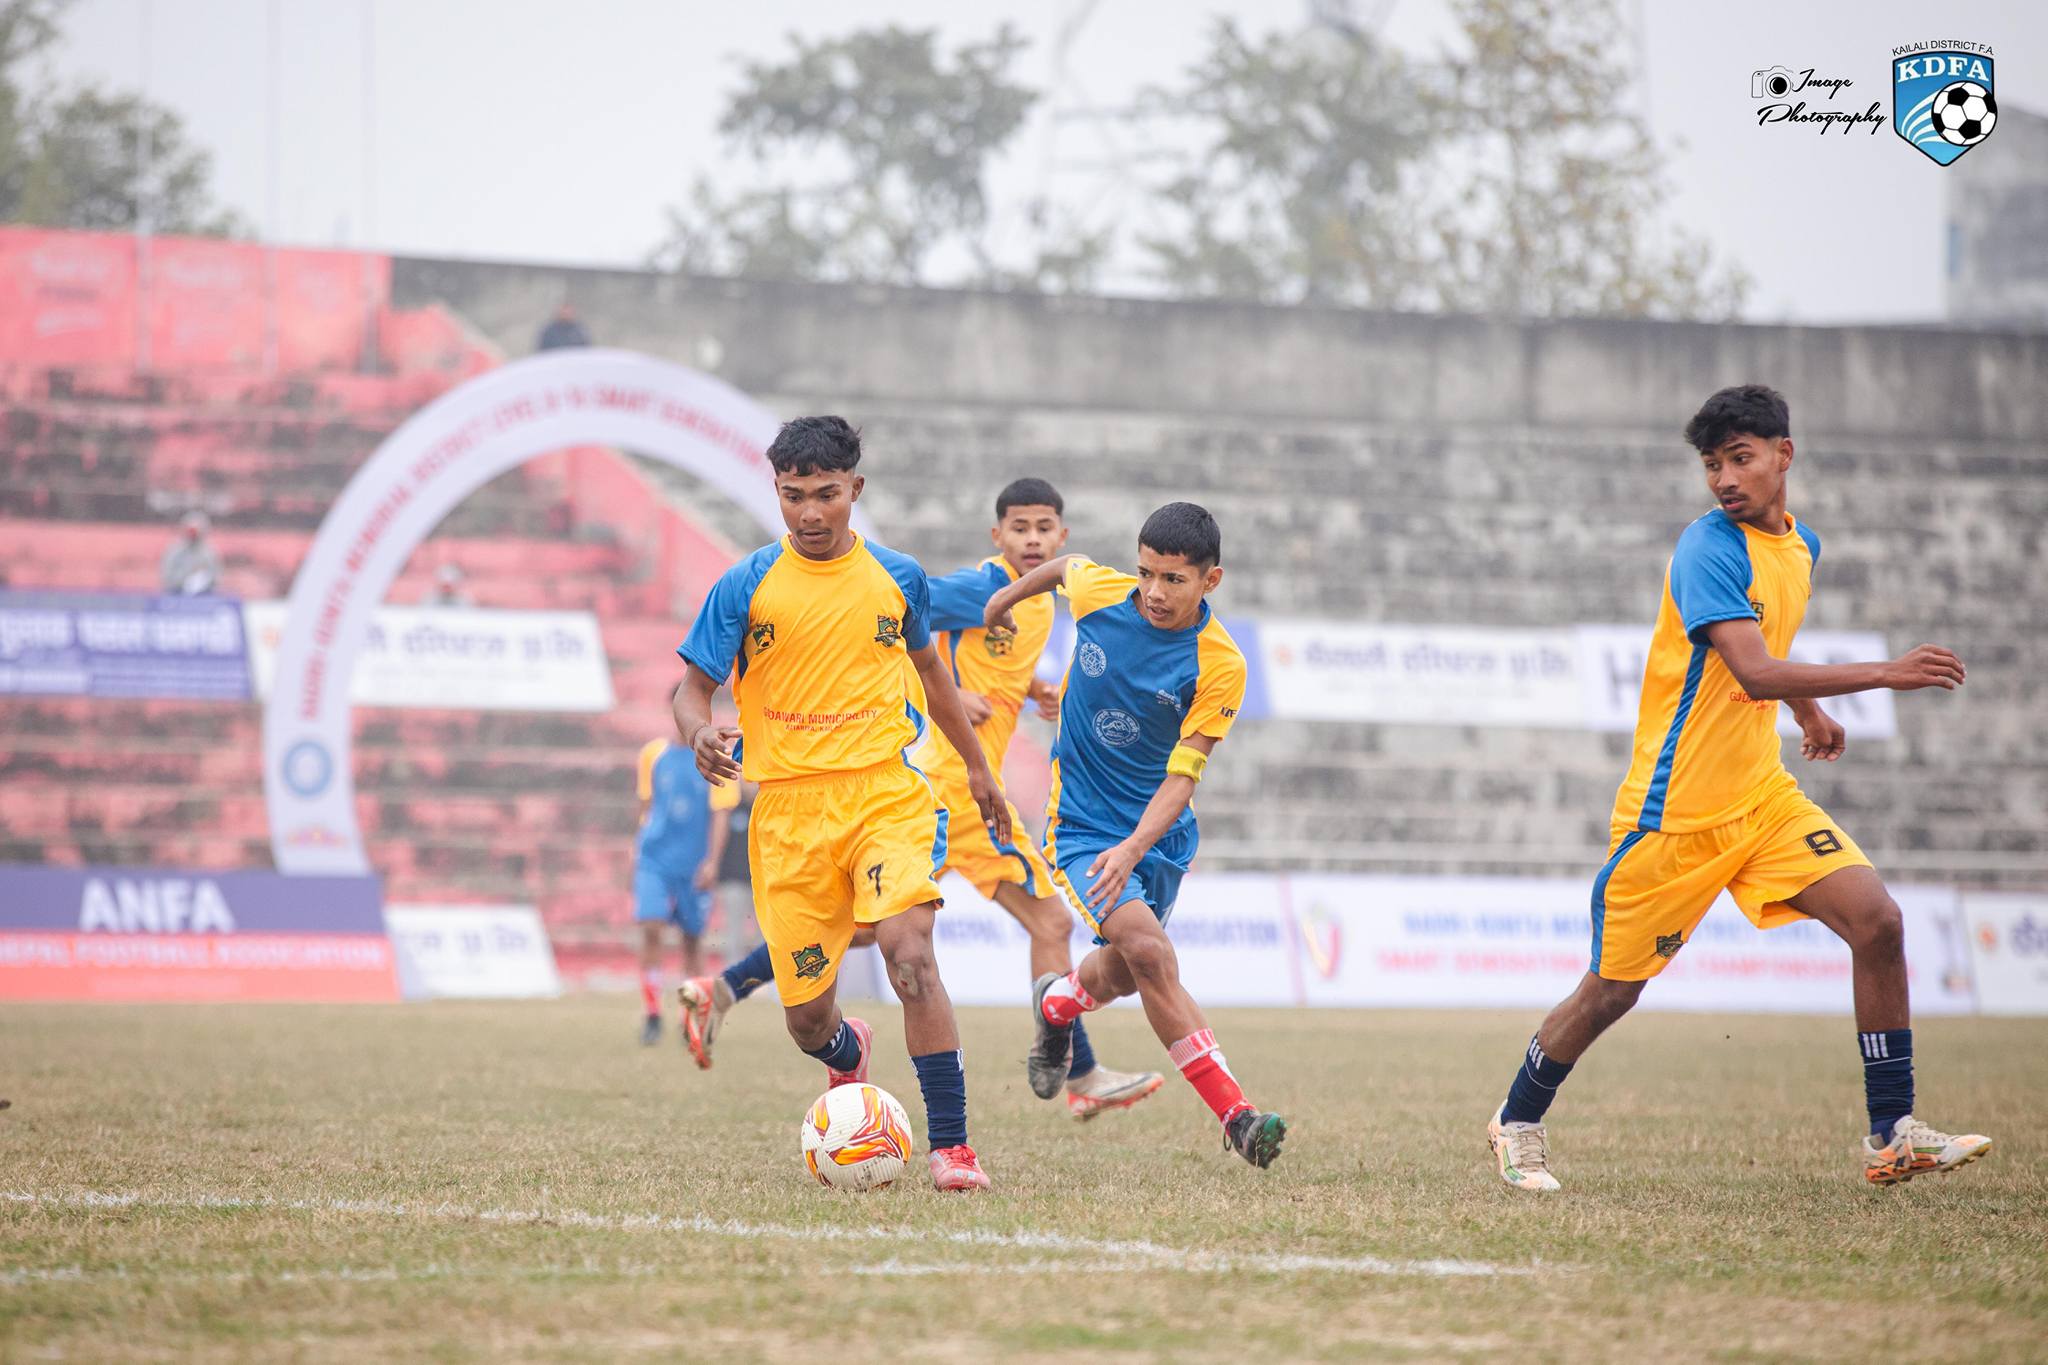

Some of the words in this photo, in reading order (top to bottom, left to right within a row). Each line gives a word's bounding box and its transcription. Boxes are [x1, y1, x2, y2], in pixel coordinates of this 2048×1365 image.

[1804, 829, 1843, 857] 9
[867, 862, 884, 897] 7
[79, 878, 235, 933] ANFA
